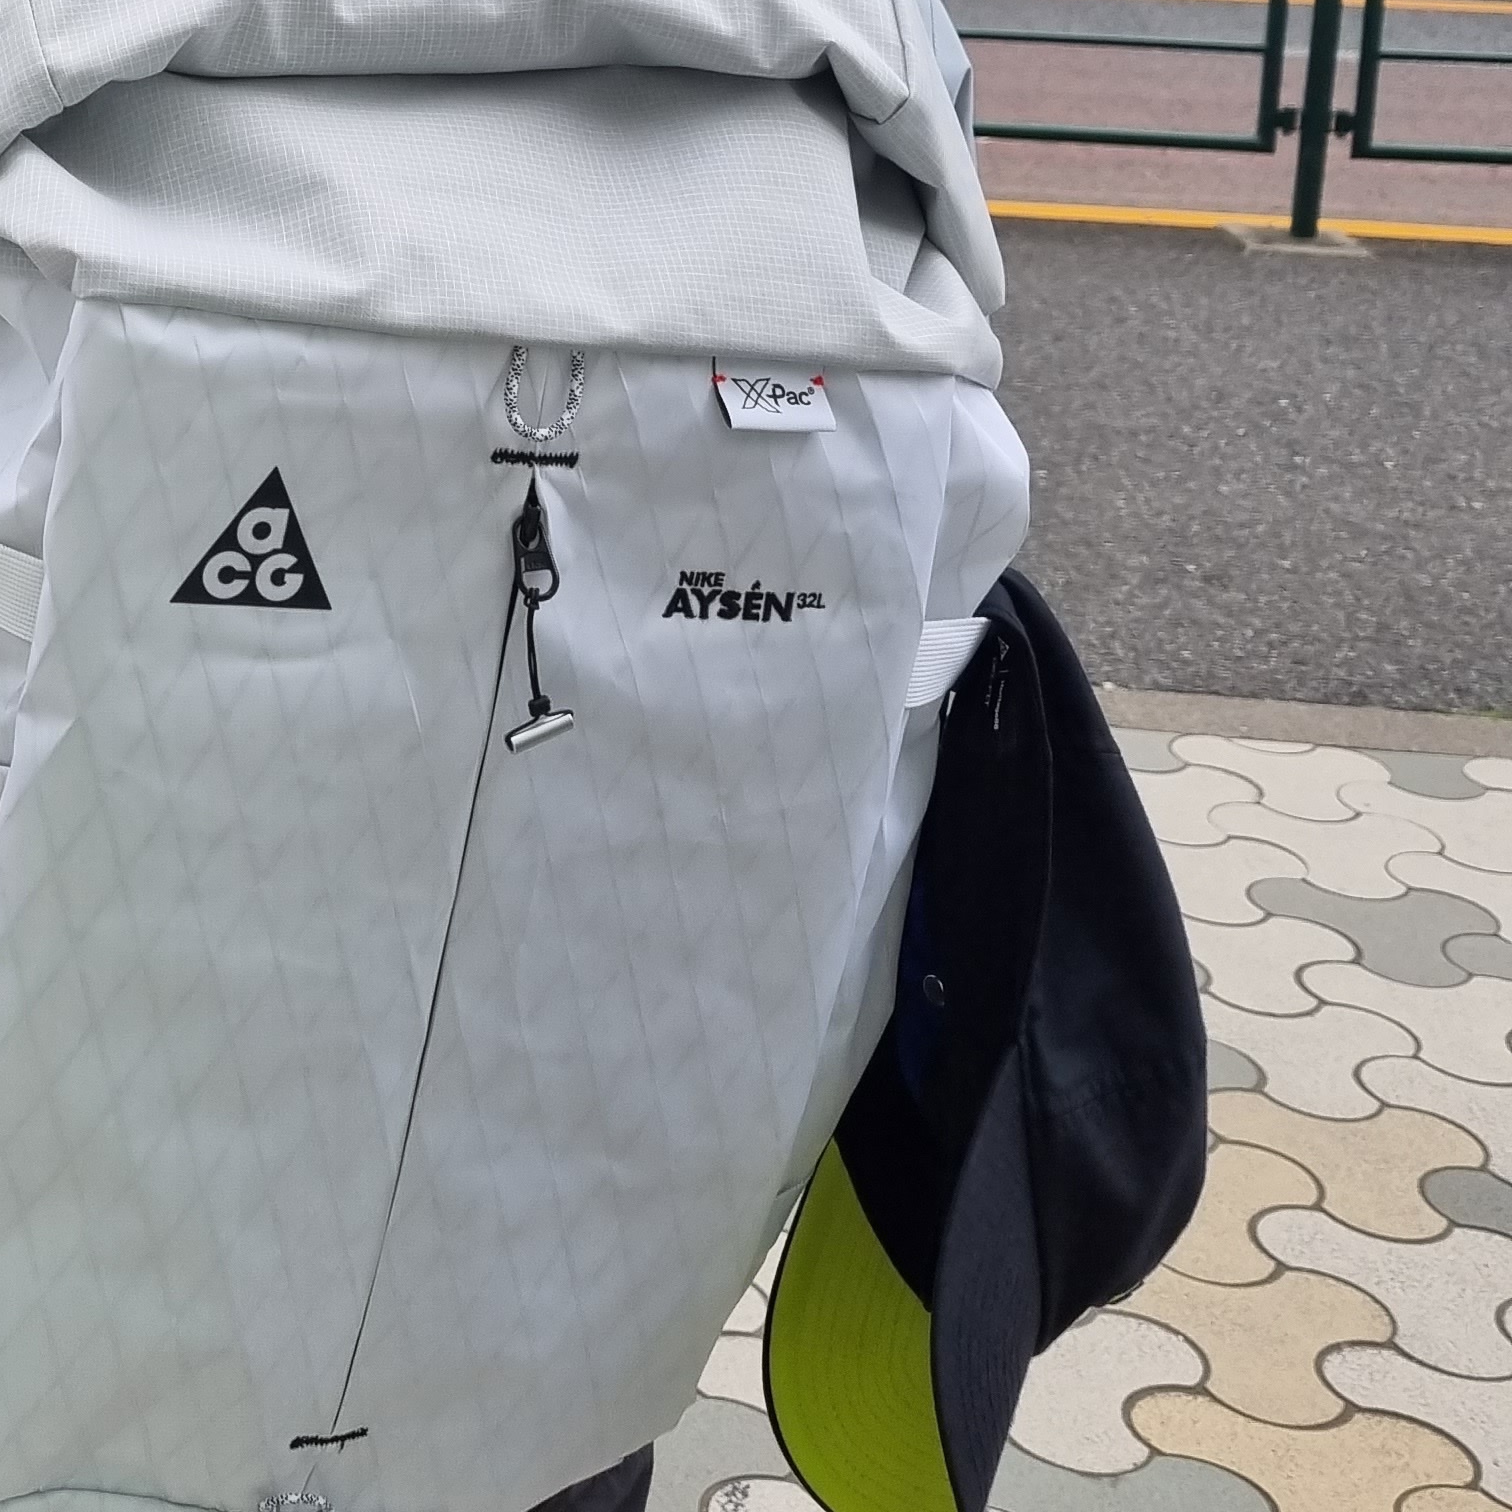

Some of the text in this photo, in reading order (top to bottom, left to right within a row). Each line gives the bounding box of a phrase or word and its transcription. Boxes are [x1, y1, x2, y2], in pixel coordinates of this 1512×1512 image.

[678, 570, 726, 588] NIKE
[661, 579, 826, 623] AYSÉN 32L
